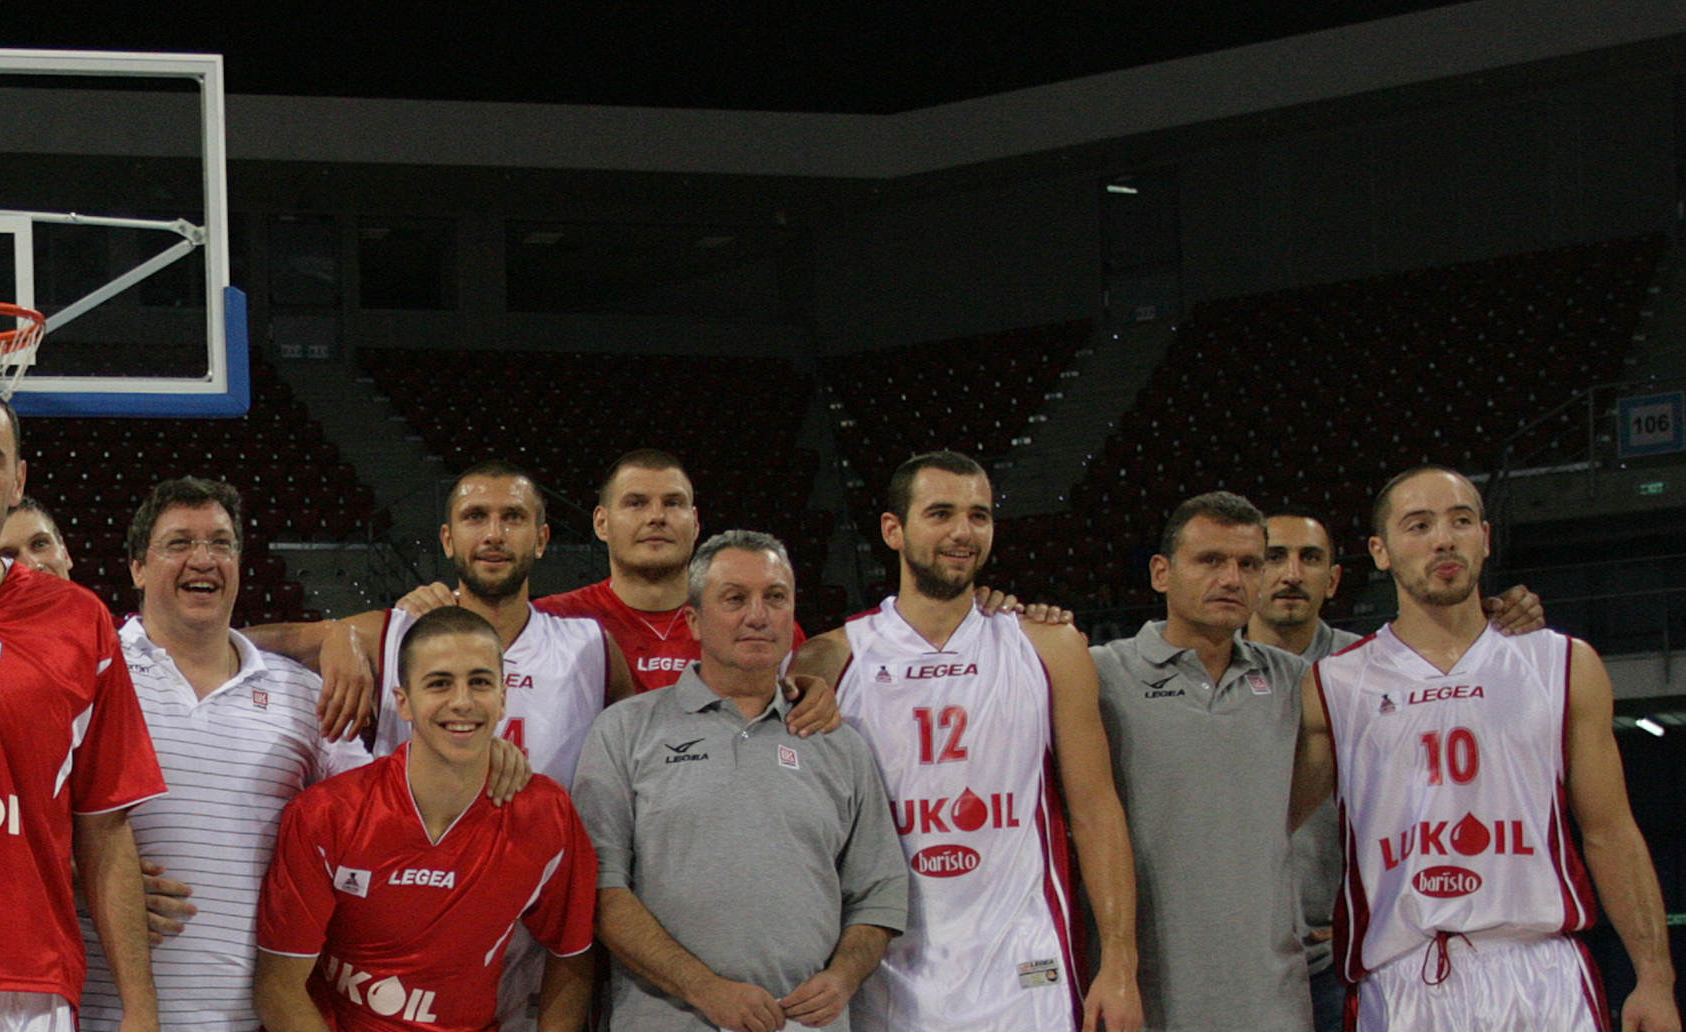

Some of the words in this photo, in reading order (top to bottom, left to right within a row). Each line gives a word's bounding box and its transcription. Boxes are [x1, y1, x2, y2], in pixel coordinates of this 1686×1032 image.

[1633, 414, 1670, 434] 106
[637, 657, 694, 672] LEGE
[905, 663, 978, 680] LEGEA
[1145, 688, 1186, 699] LEGEA
[1409, 684, 1485, 706] LEGEA
[914, 705, 969, 765] 12
[665, 753, 709, 765] LEGEA
[1419, 726, 1480, 786] 10
[890, 786, 1020, 836] UKOIL
[1378, 811, 1534, 871] LUKOIL
[388, 869, 456, 890] LEGEA
[1030, 957, 1055, 968] LEGEA
[322, 955, 437, 1024] UKOIL
